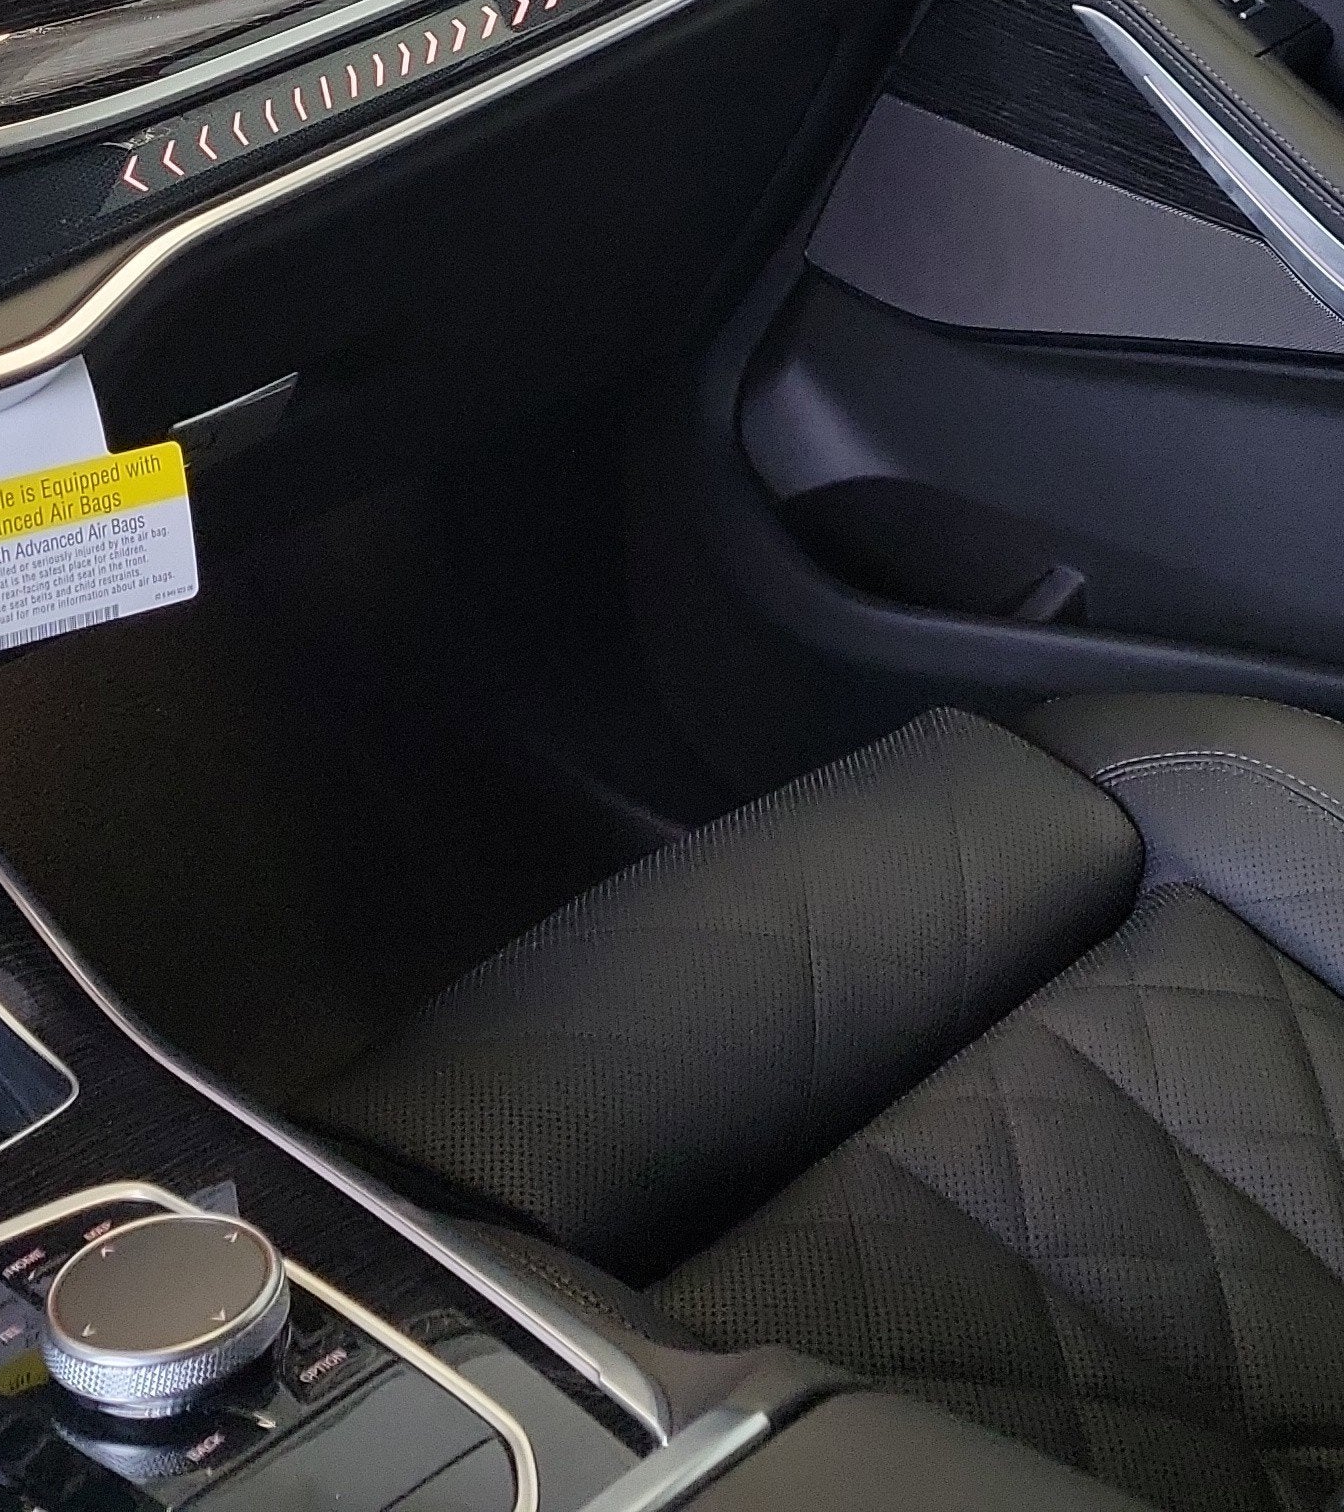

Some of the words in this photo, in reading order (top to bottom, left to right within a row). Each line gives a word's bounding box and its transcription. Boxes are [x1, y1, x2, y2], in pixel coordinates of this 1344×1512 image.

[20, 485, 35, 503] is
[41, 463, 120, 499] Equipped
[125, 454, 161, 478] with
[50, 501, 74, 523] Air
[80, 491, 122, 515] Bags
[15, 528, 83, 560] Advanced
[88, 523, 107, 542] Air
[111, 515, 145, 535] Bags
[19, 562, 30, 572] or
[32, 551, 72, 569] seriously
[74, 542, 105, 558] injured
[108, 539, 119, 550] by
[121, 534, 135, 544] the
[137, 531, 148, 541] air
[151, 527, 170, 539] bag.
[1, 578, 50, 602] rear-facing
[53, 573, 74, 588] child
[77, 568, 95, 581] seat
[98, 565, 107, 575] in
[109, 561, 122, 572] the
[125, 554, 149, 568] front.
[11, 577, 20, 587] is
[22, 572, 36, 584] the
[39, 564, 66, 579] safest
[69, 558, 91, 572] place
[94, 555, 107, 565] for
[109, 544, 147, 560] children.
[10, 597, 28, 610] seat
[31, 589, 53, 604] belts
[55, 586, 71, 597] and
[74, 578, 97, 593] child
[16, 609, 30, 620] for
[32, 603, 56, 615] more
[58, 587, 109, 609] information
[111, 580, 136, 594] about
[138, 576, 150, 588] air
[152, 570, 175, 583] bags.
[299, 1347, 348, 1383] OPTION
